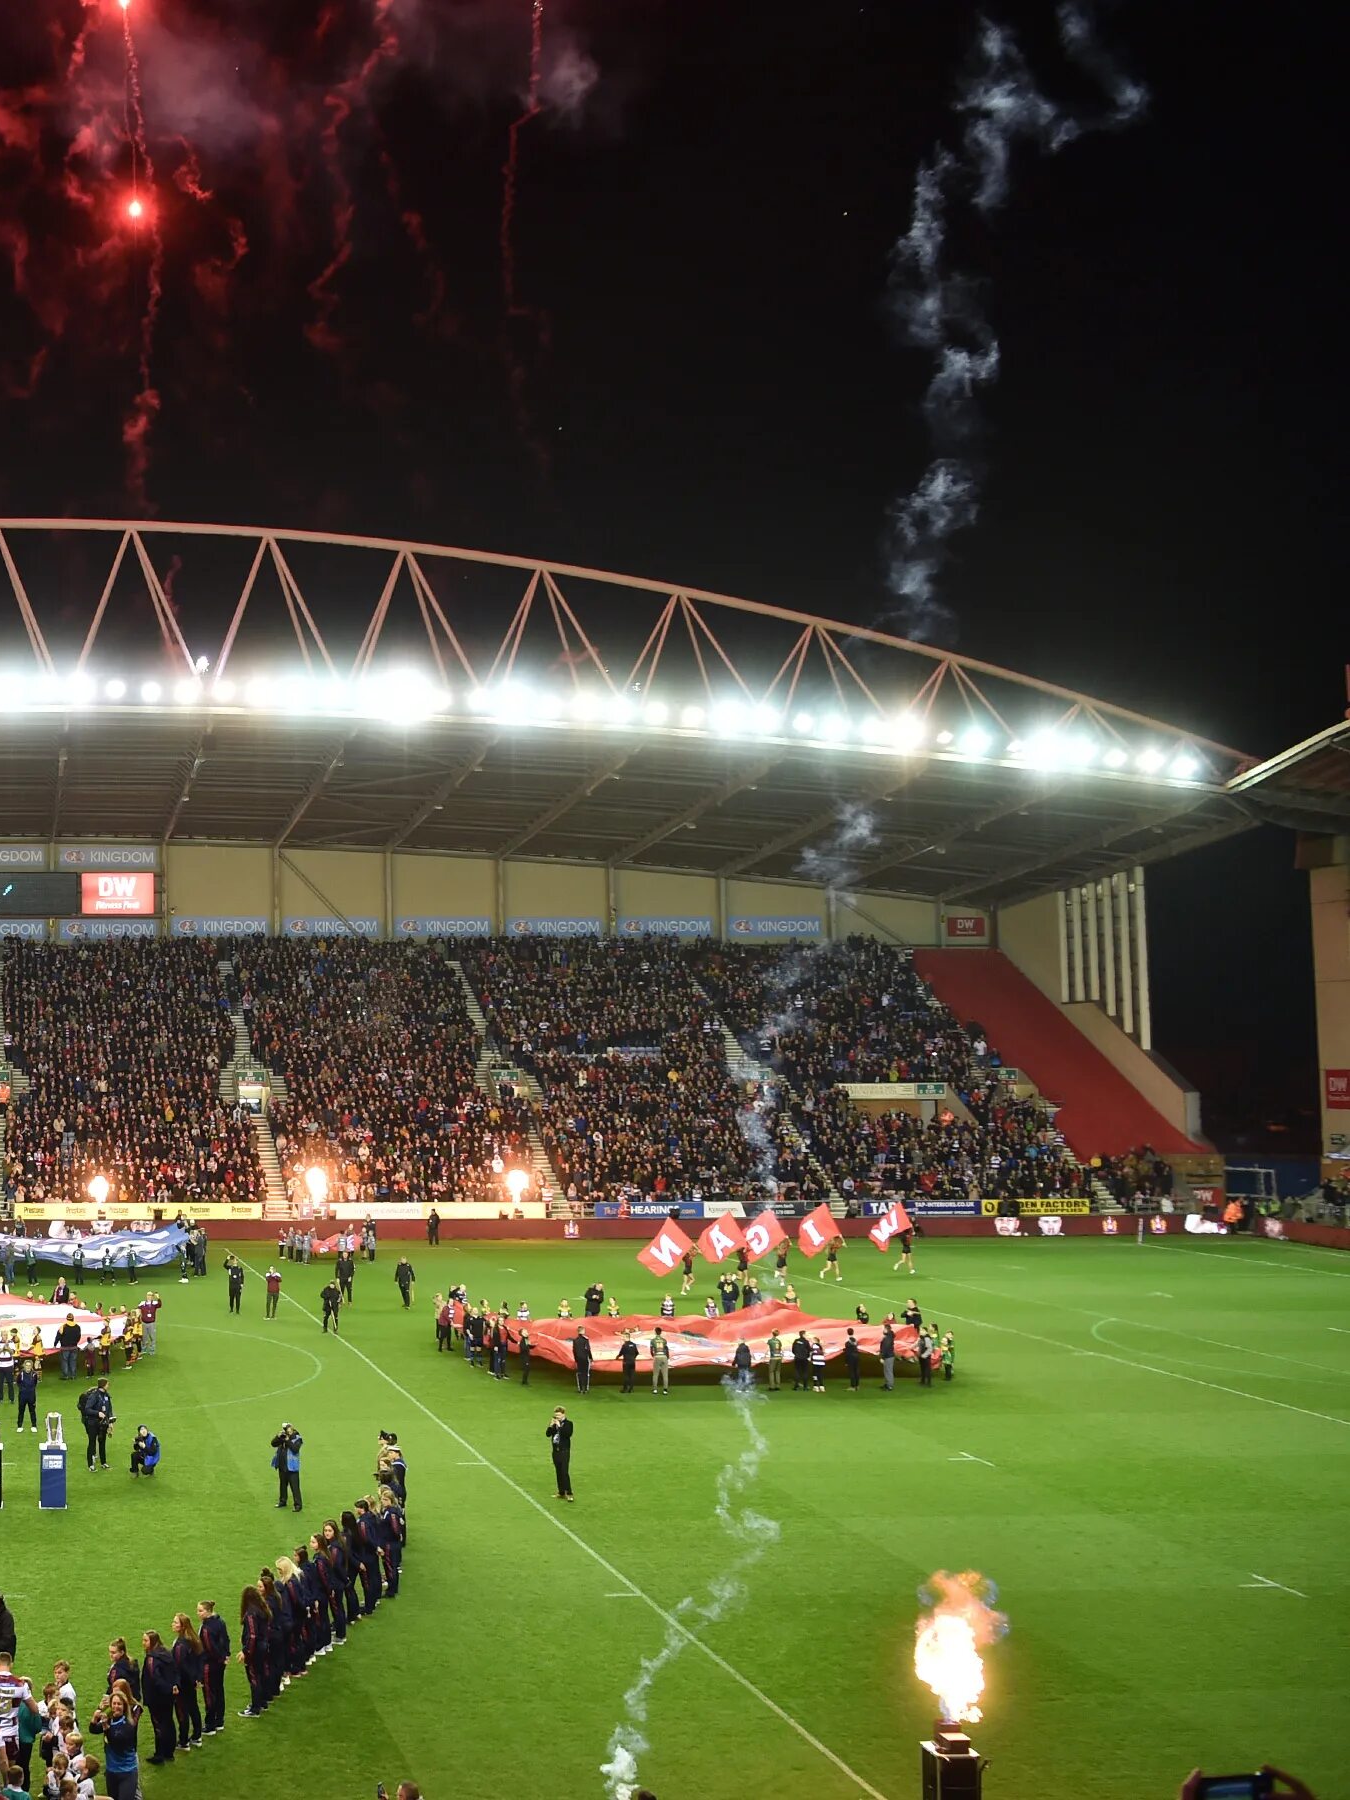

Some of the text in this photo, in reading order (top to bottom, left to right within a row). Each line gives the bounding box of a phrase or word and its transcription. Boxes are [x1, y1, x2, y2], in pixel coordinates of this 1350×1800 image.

[90, 851, 154, 863] KINGDOM
[98, 877, 137, 897] DW
[90, 924, 154, 936] KINGDOM
[203, 921, 266, 933] KINGDOM
[314, 921, 377, 933] KINGDOM
[426, 921, 489, 933] KINGDOM
[537, 921, 600, 933] KINGDOM
[648, 921, 711, 933] KINGDOM
[757, 921, 819, 933] KINGDOM
[957, 920, 974, 928] DW
[302, 1207, 326, 1216] FT
